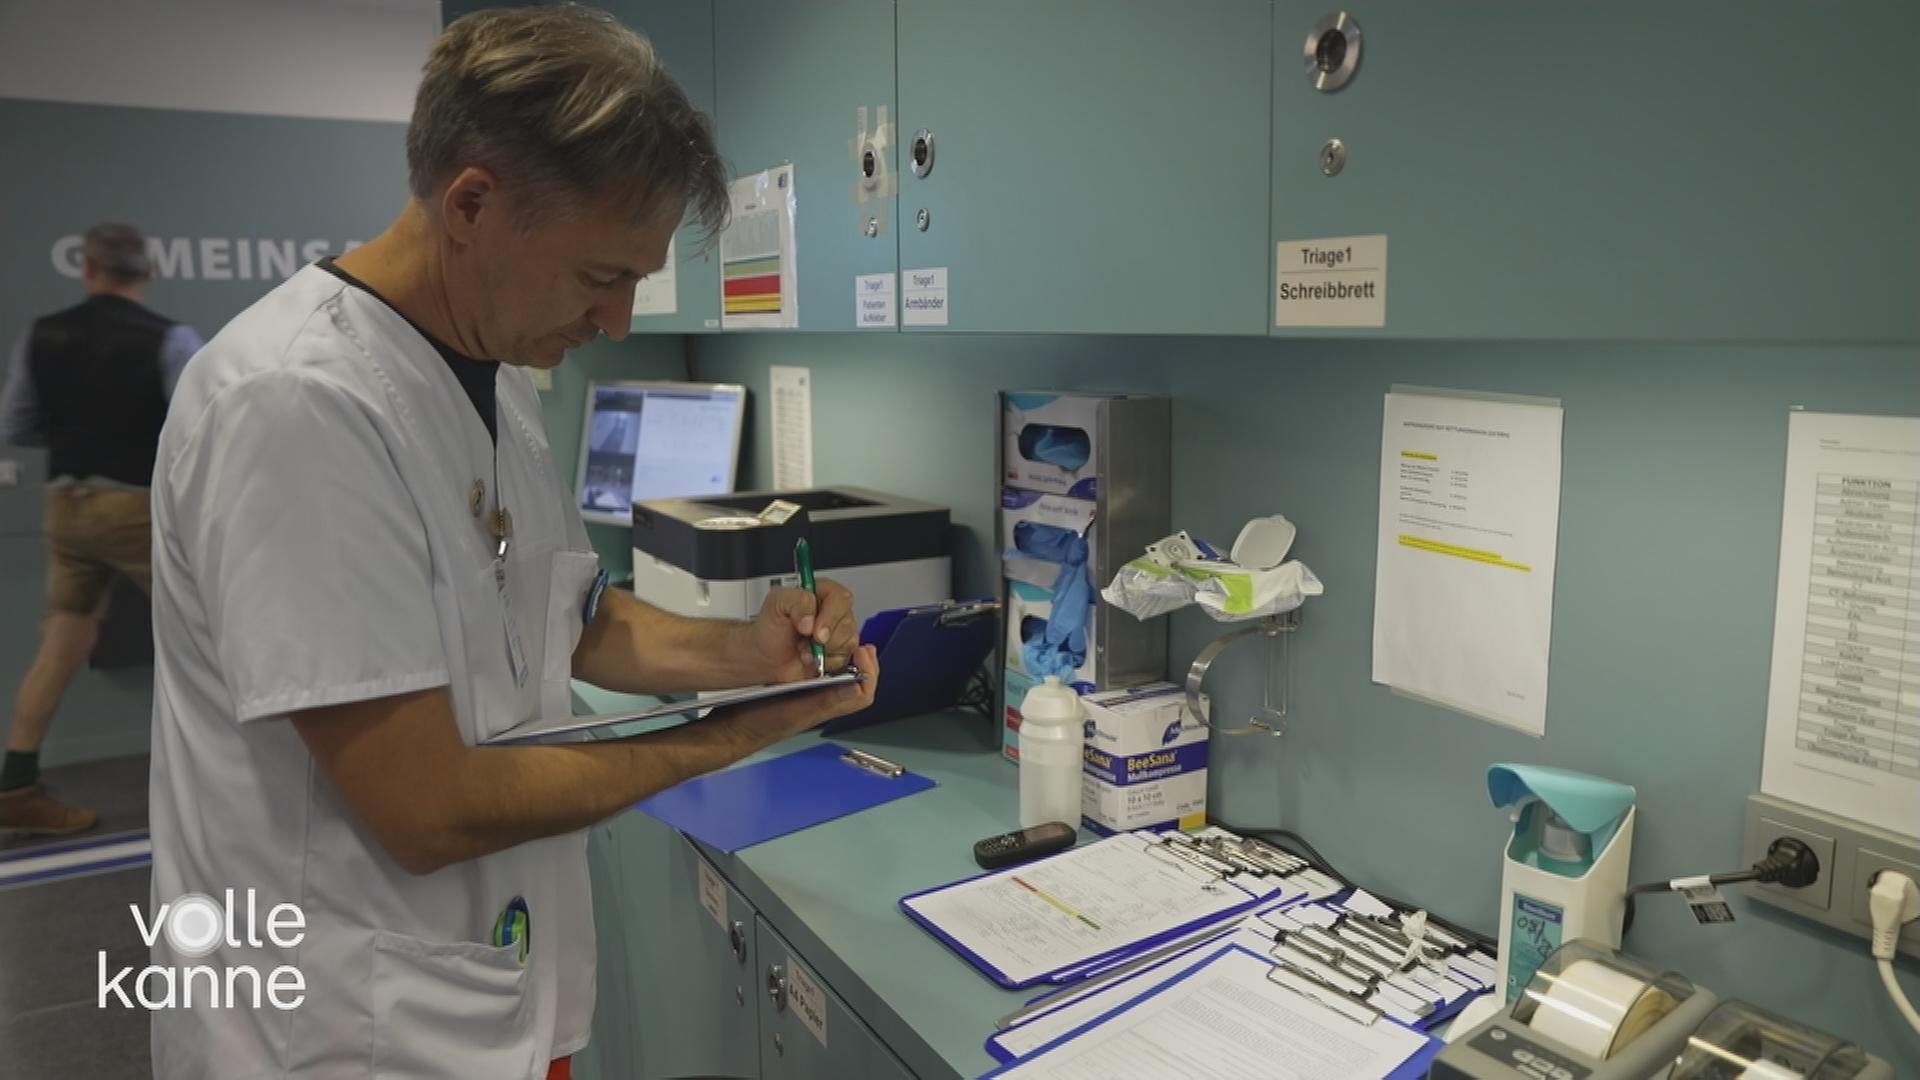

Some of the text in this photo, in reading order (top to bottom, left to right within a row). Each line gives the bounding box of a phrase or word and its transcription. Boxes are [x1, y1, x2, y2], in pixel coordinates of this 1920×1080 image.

[50, 235, 363, 280] GMEINS
[1301, 246, 1352, 268] Triage1
[1280, 280, 1375, 300] Schreibbrett
[1841, 476, 1892, 489] FUNKTION
[1127, 751, 1176, 771] BeeSana
